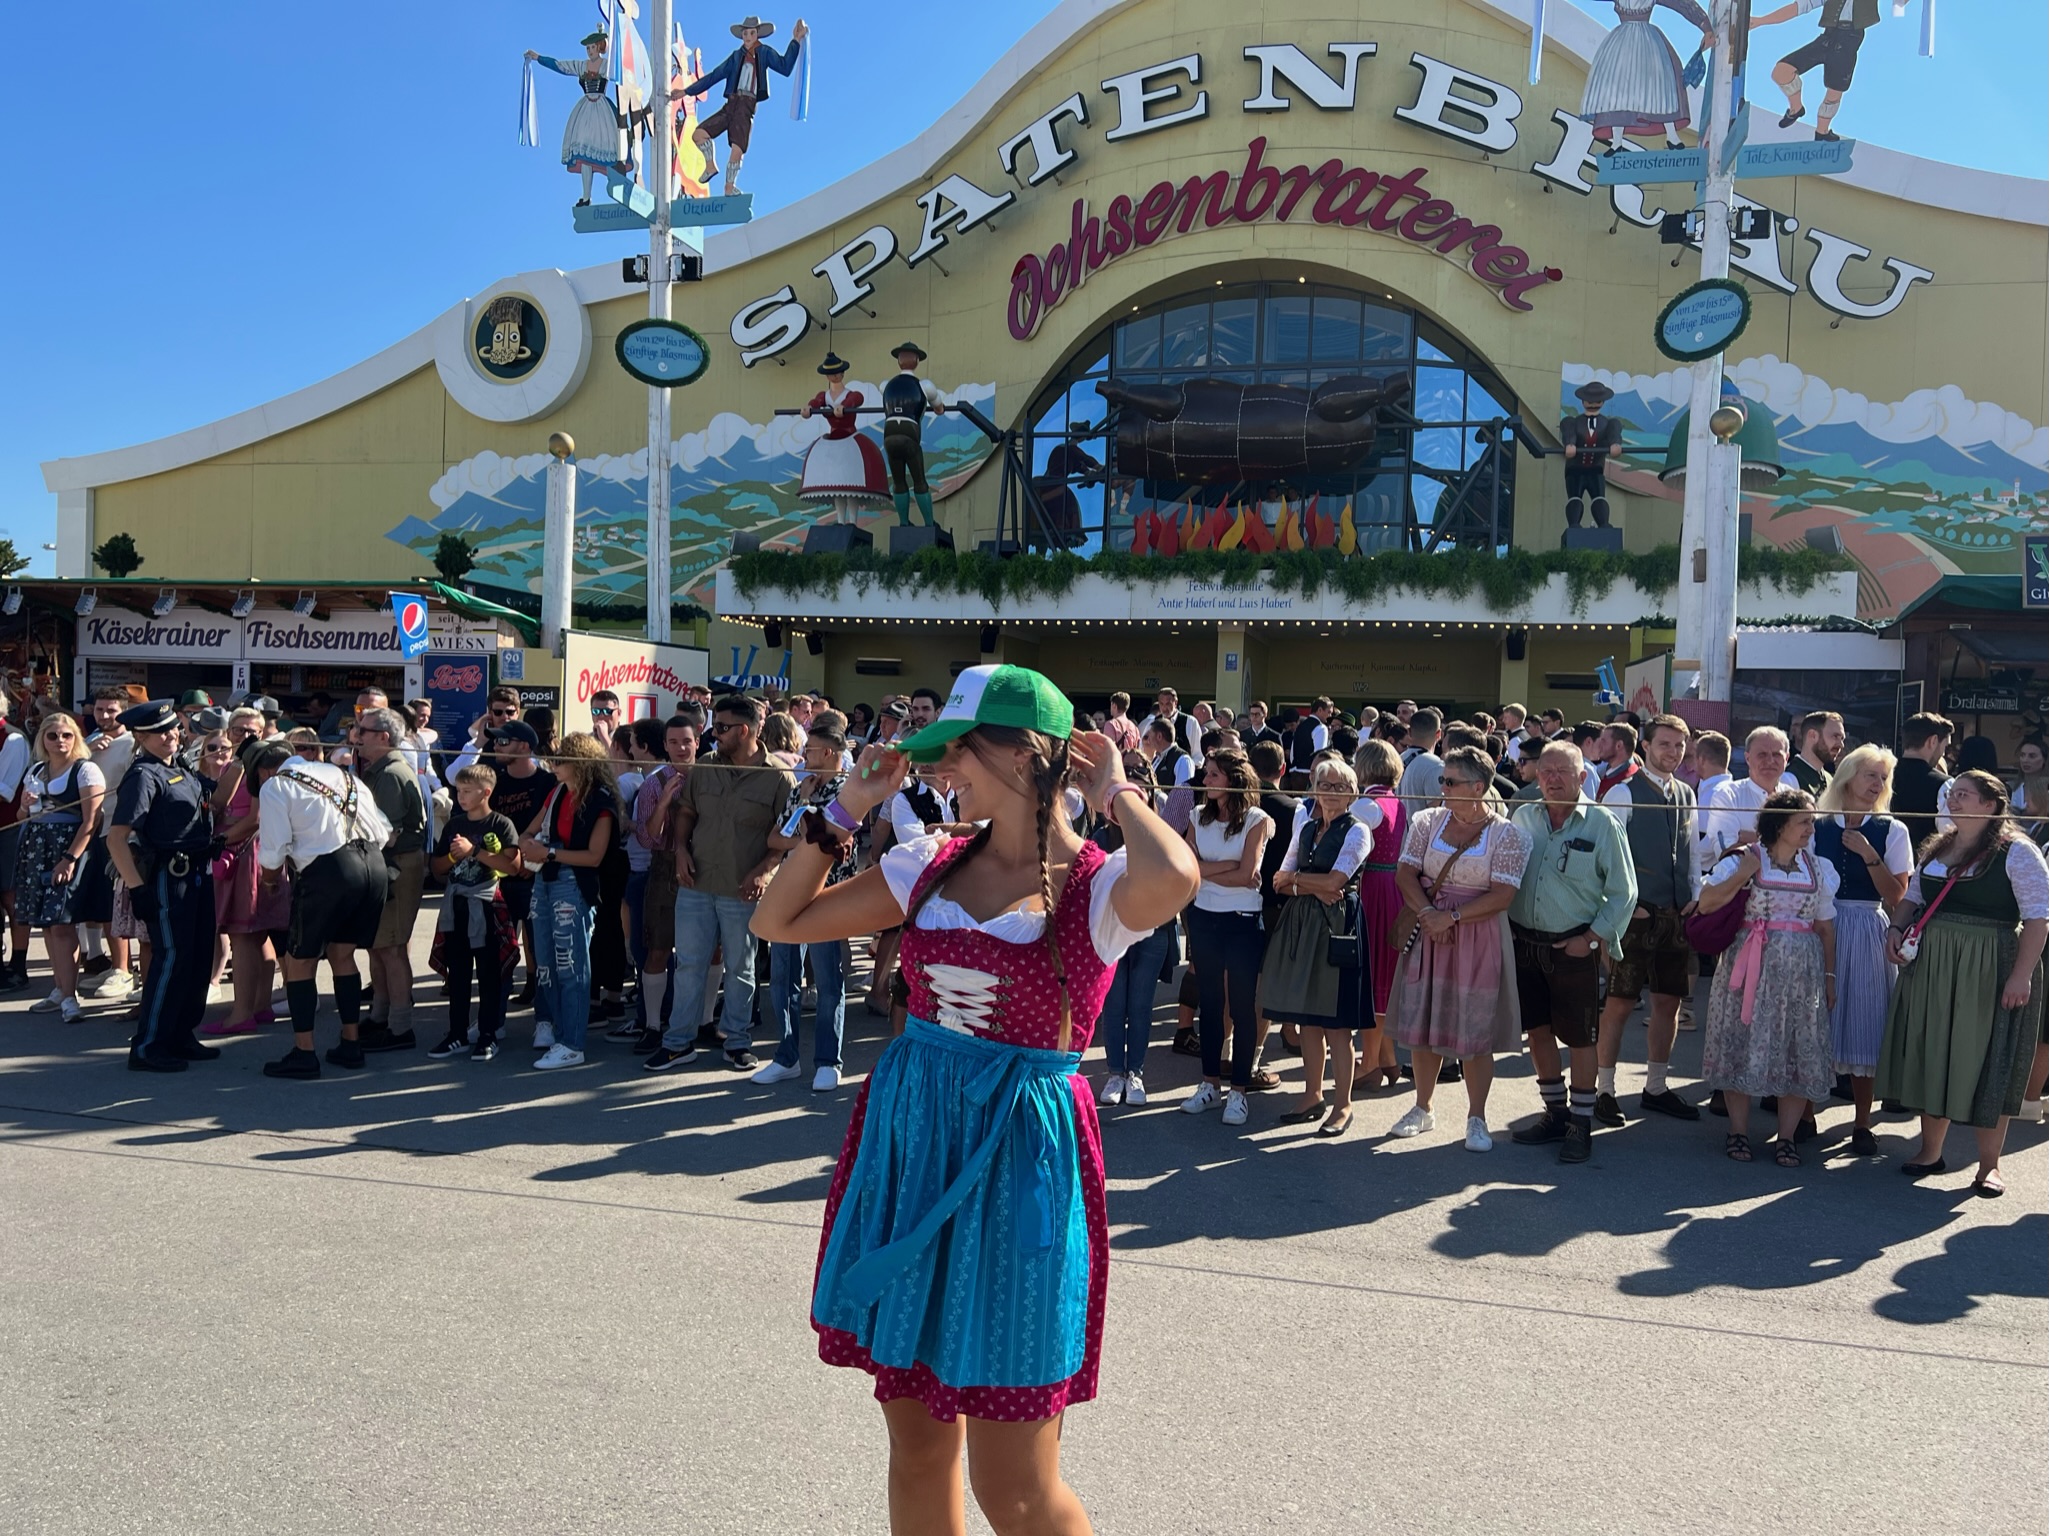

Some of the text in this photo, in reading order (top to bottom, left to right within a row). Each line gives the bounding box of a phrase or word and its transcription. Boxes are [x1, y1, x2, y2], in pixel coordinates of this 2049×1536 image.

[1610, 154, 1700, 171] Eisensteinerin
[683, 200, 727, 216] Ötztaler
[1007, 136, 1564, 342] Ochsenbraterei
[1675, 308, 1690, 317] von
[1706, 296, 1718, 310] bis
[1664, 305, 1742, 336] zünftige Blasmusik
[635, 335, 650, 345] von
[666, 335, 678, 347] bis
[624, 345, 702, 361] zünftige Blasmusik
[1157, 597, 1293, 609] Antje Haberl und Luis Haberl
[438, 614, 454, 623] seit
[87, 618, 231, 648] Käsekrainer
[432, 637, 486, 650] WIESN
[505, 653, 519, 663] 90
[577, 655, 691, 703] Ochsenbratere
[520, 691, 554, 702] pepsi
